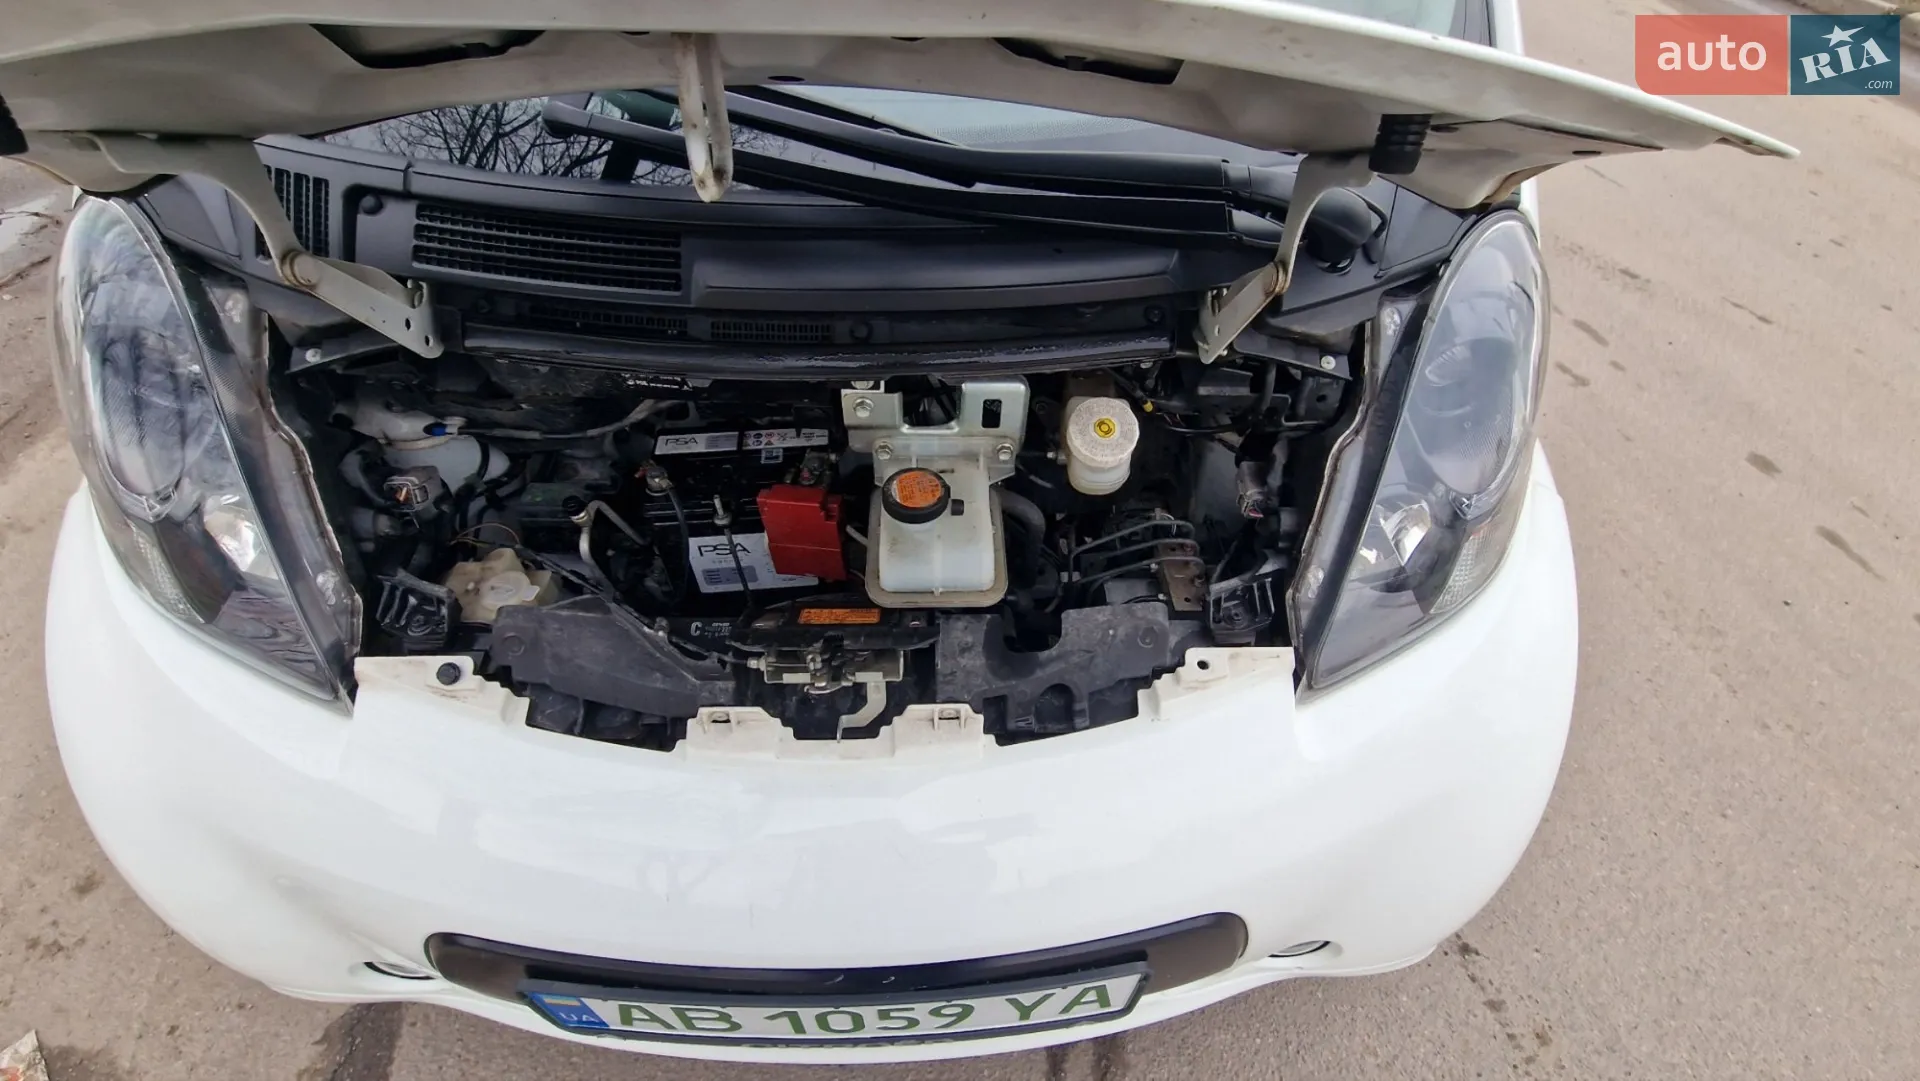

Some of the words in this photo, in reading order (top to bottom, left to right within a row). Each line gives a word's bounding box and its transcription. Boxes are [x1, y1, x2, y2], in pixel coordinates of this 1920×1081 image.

[665, 437, 698, 446] PSA
[697, 542, 751, 557] PSA
[618, 1003, 743, 1032] AB
[763, 1003, 975, 1035] 1059
[1004, 984, 1112, 1021] YA
[559, 1012, 599, 1023] UA
